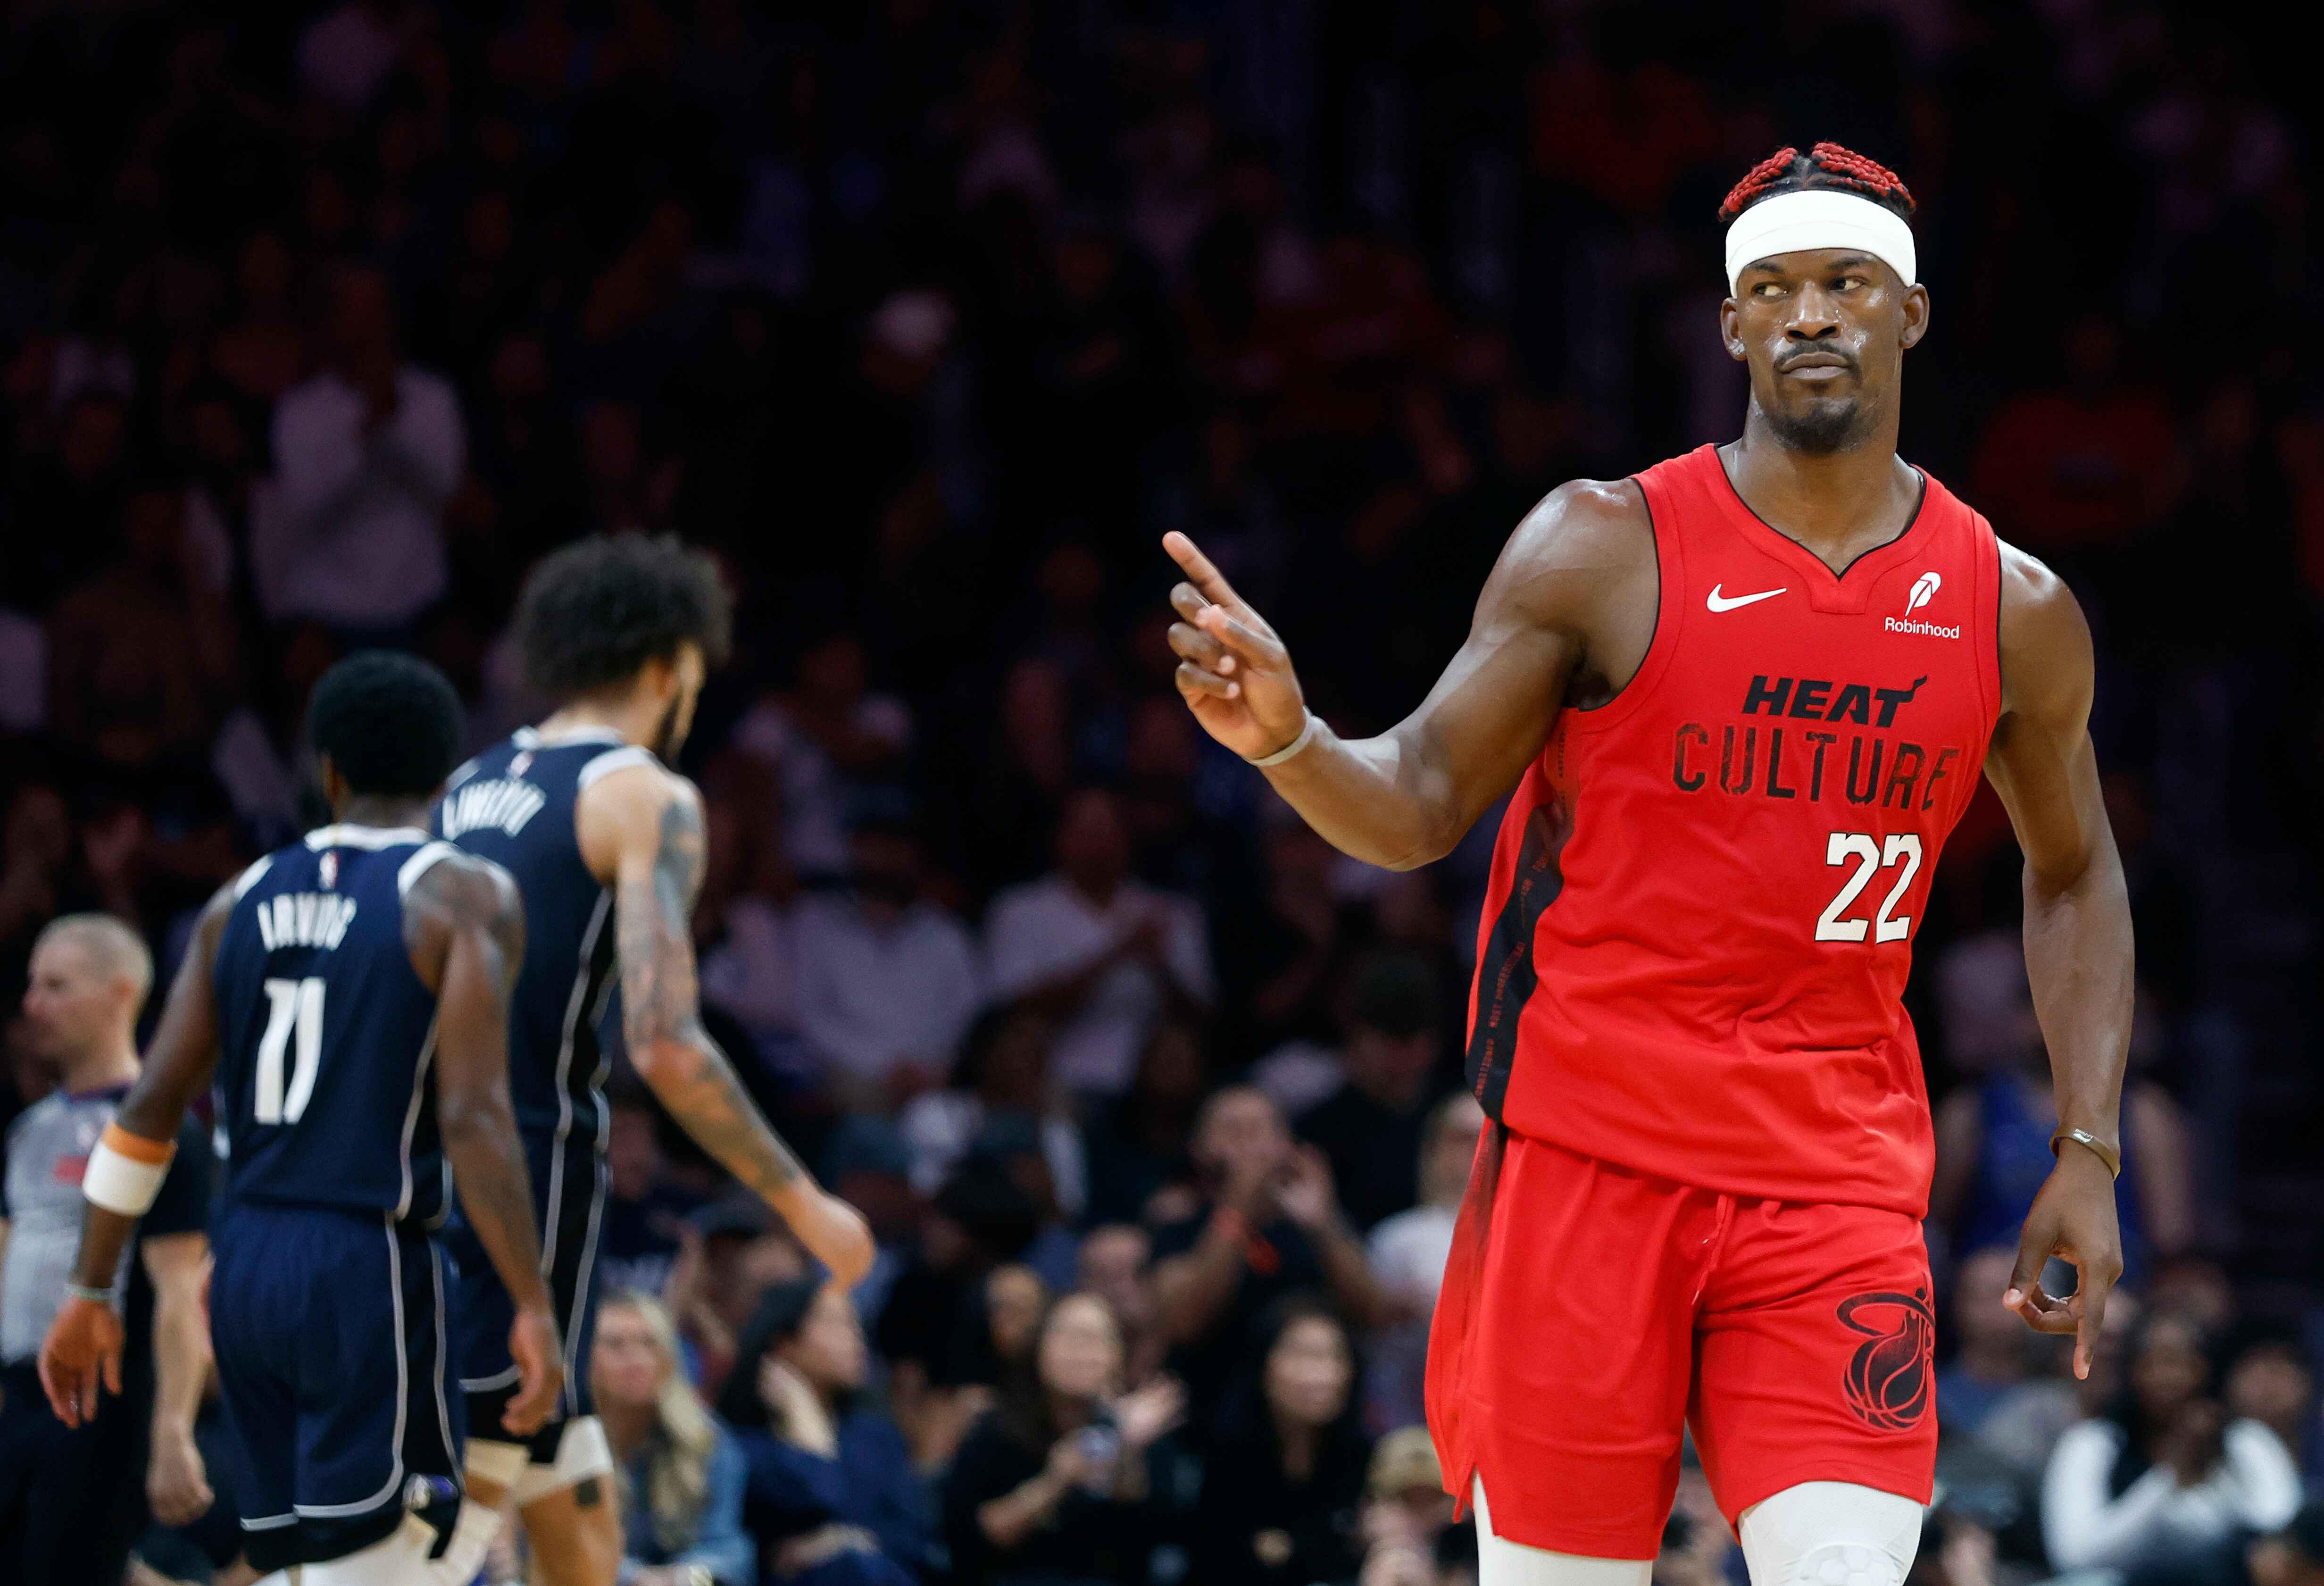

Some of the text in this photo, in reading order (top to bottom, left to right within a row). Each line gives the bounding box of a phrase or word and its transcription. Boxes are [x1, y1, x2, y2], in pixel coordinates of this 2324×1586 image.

[1884, 617, 1960, 639] Robinhood
[1742, 675, 1928, 728] HEAT
[1673, 723, 1961, 811] CULTURE
[1815, 832, 1922, 944] 22
[254, 977, 326, 1125] 11
